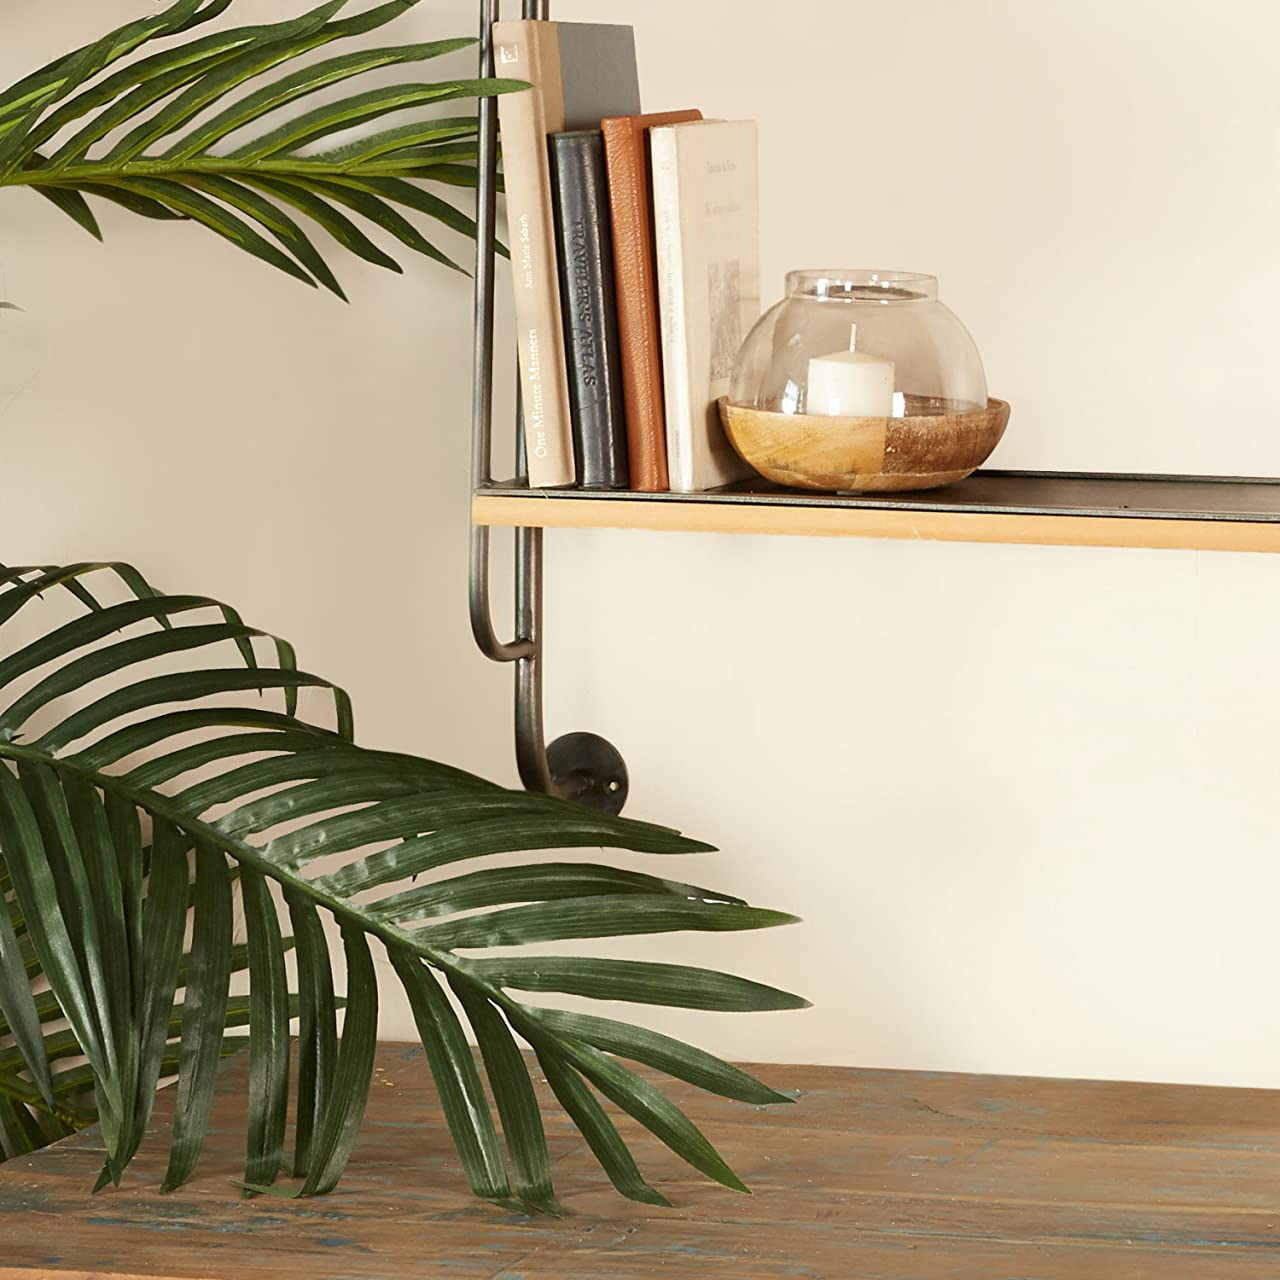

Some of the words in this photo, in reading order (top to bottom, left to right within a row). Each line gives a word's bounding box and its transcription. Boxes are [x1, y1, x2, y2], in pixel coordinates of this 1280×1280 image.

[521, 244, 532, 270] Marie
[573, 217, 592, 322] TRAVELER'S
[528, 328, 541, 380] Manners
[580, 328, 596, 387] ATLAS
[532, 383, 545, 429] Minute
[534, 431, 547, 458] One
